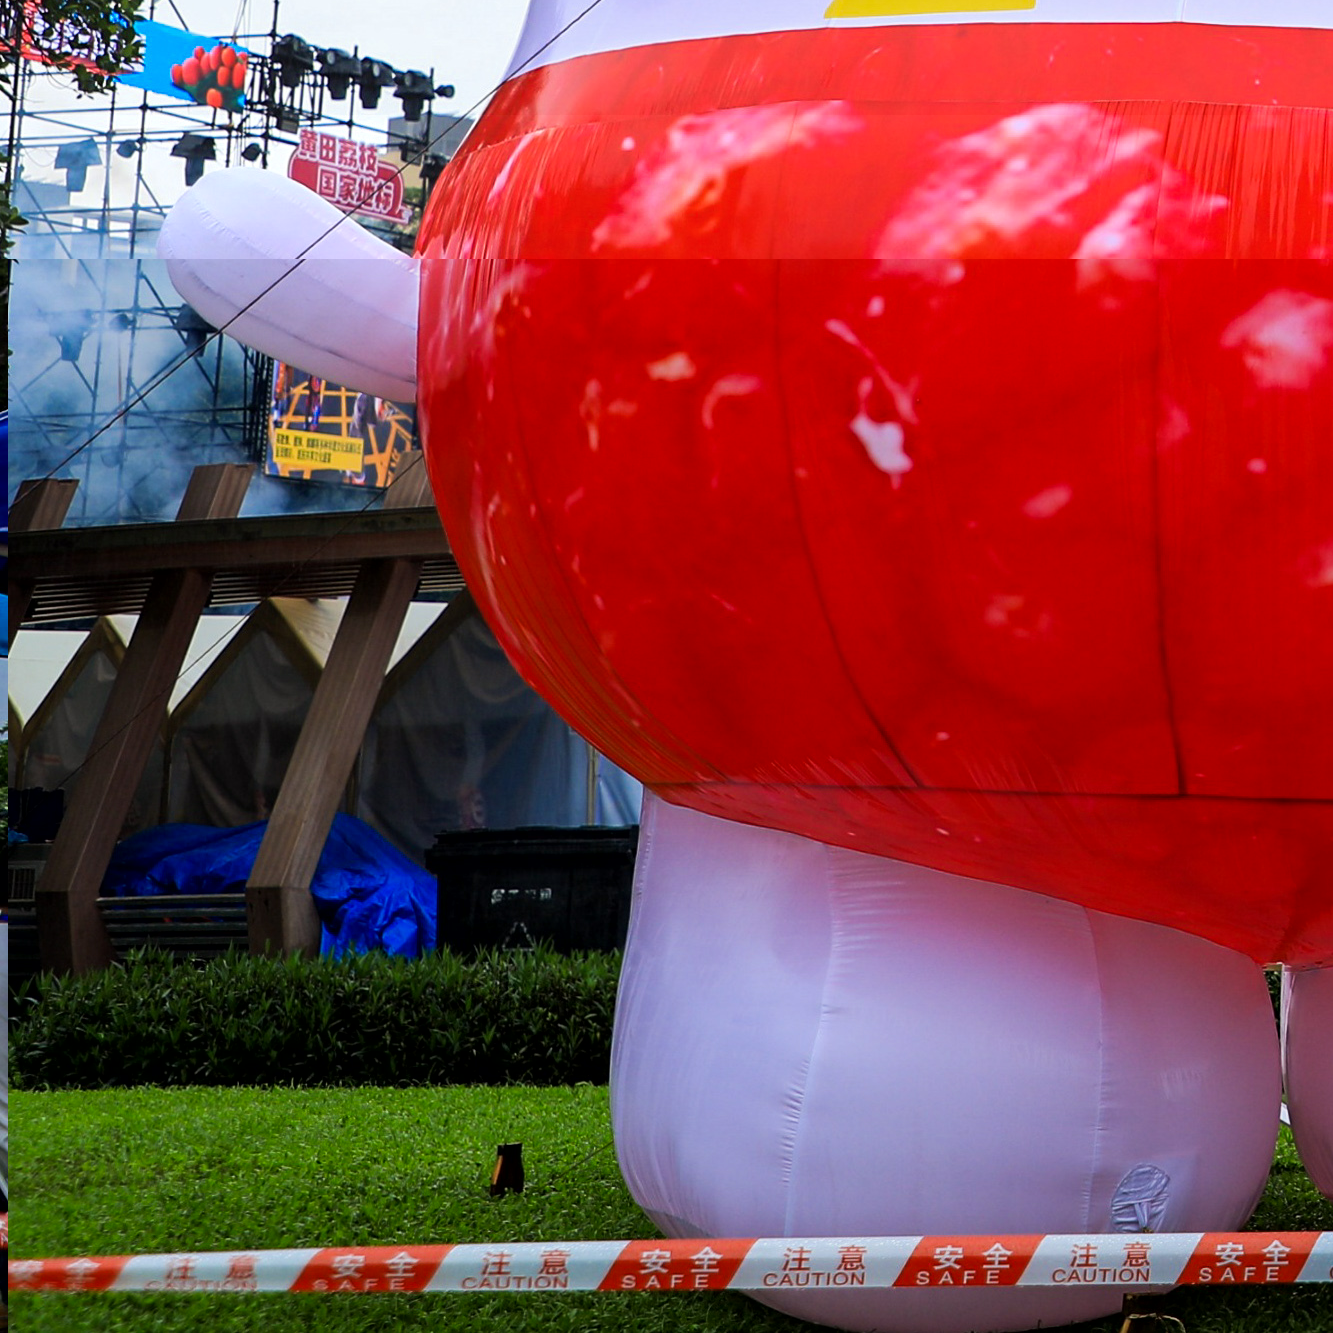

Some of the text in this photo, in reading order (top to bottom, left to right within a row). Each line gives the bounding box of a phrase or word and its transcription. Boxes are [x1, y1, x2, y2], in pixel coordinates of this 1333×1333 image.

[299, 128, 378, 174] 黄田荔枝
[319, 168, 394, 212] 国家地标
[312, 1278, 406, 1290] SAFE
[461, 1275, 569, 1289] CAUTION
[621, 1274, 709, 1289] SAFE
[763, 1272, 866, 1287] CAUTION
[916, 1270, 1000, 1285] SAFE
[1052, 1268, 1150, 1283] CAUTION
[1199, 1267, 1280, 1282] SAFE
[332, 1251, 420, 1278] 安全
[481, 1249, 571, 1276] 注意
[640, 1246, 724, 1274] 安全
[782, 1245, 867, 1271] 注意
[933, 1243, 1013, 1270] 安全
[1070, 1242, 1151, 1268] 注意
[1215, 1240, 1292, 1267] 安全
